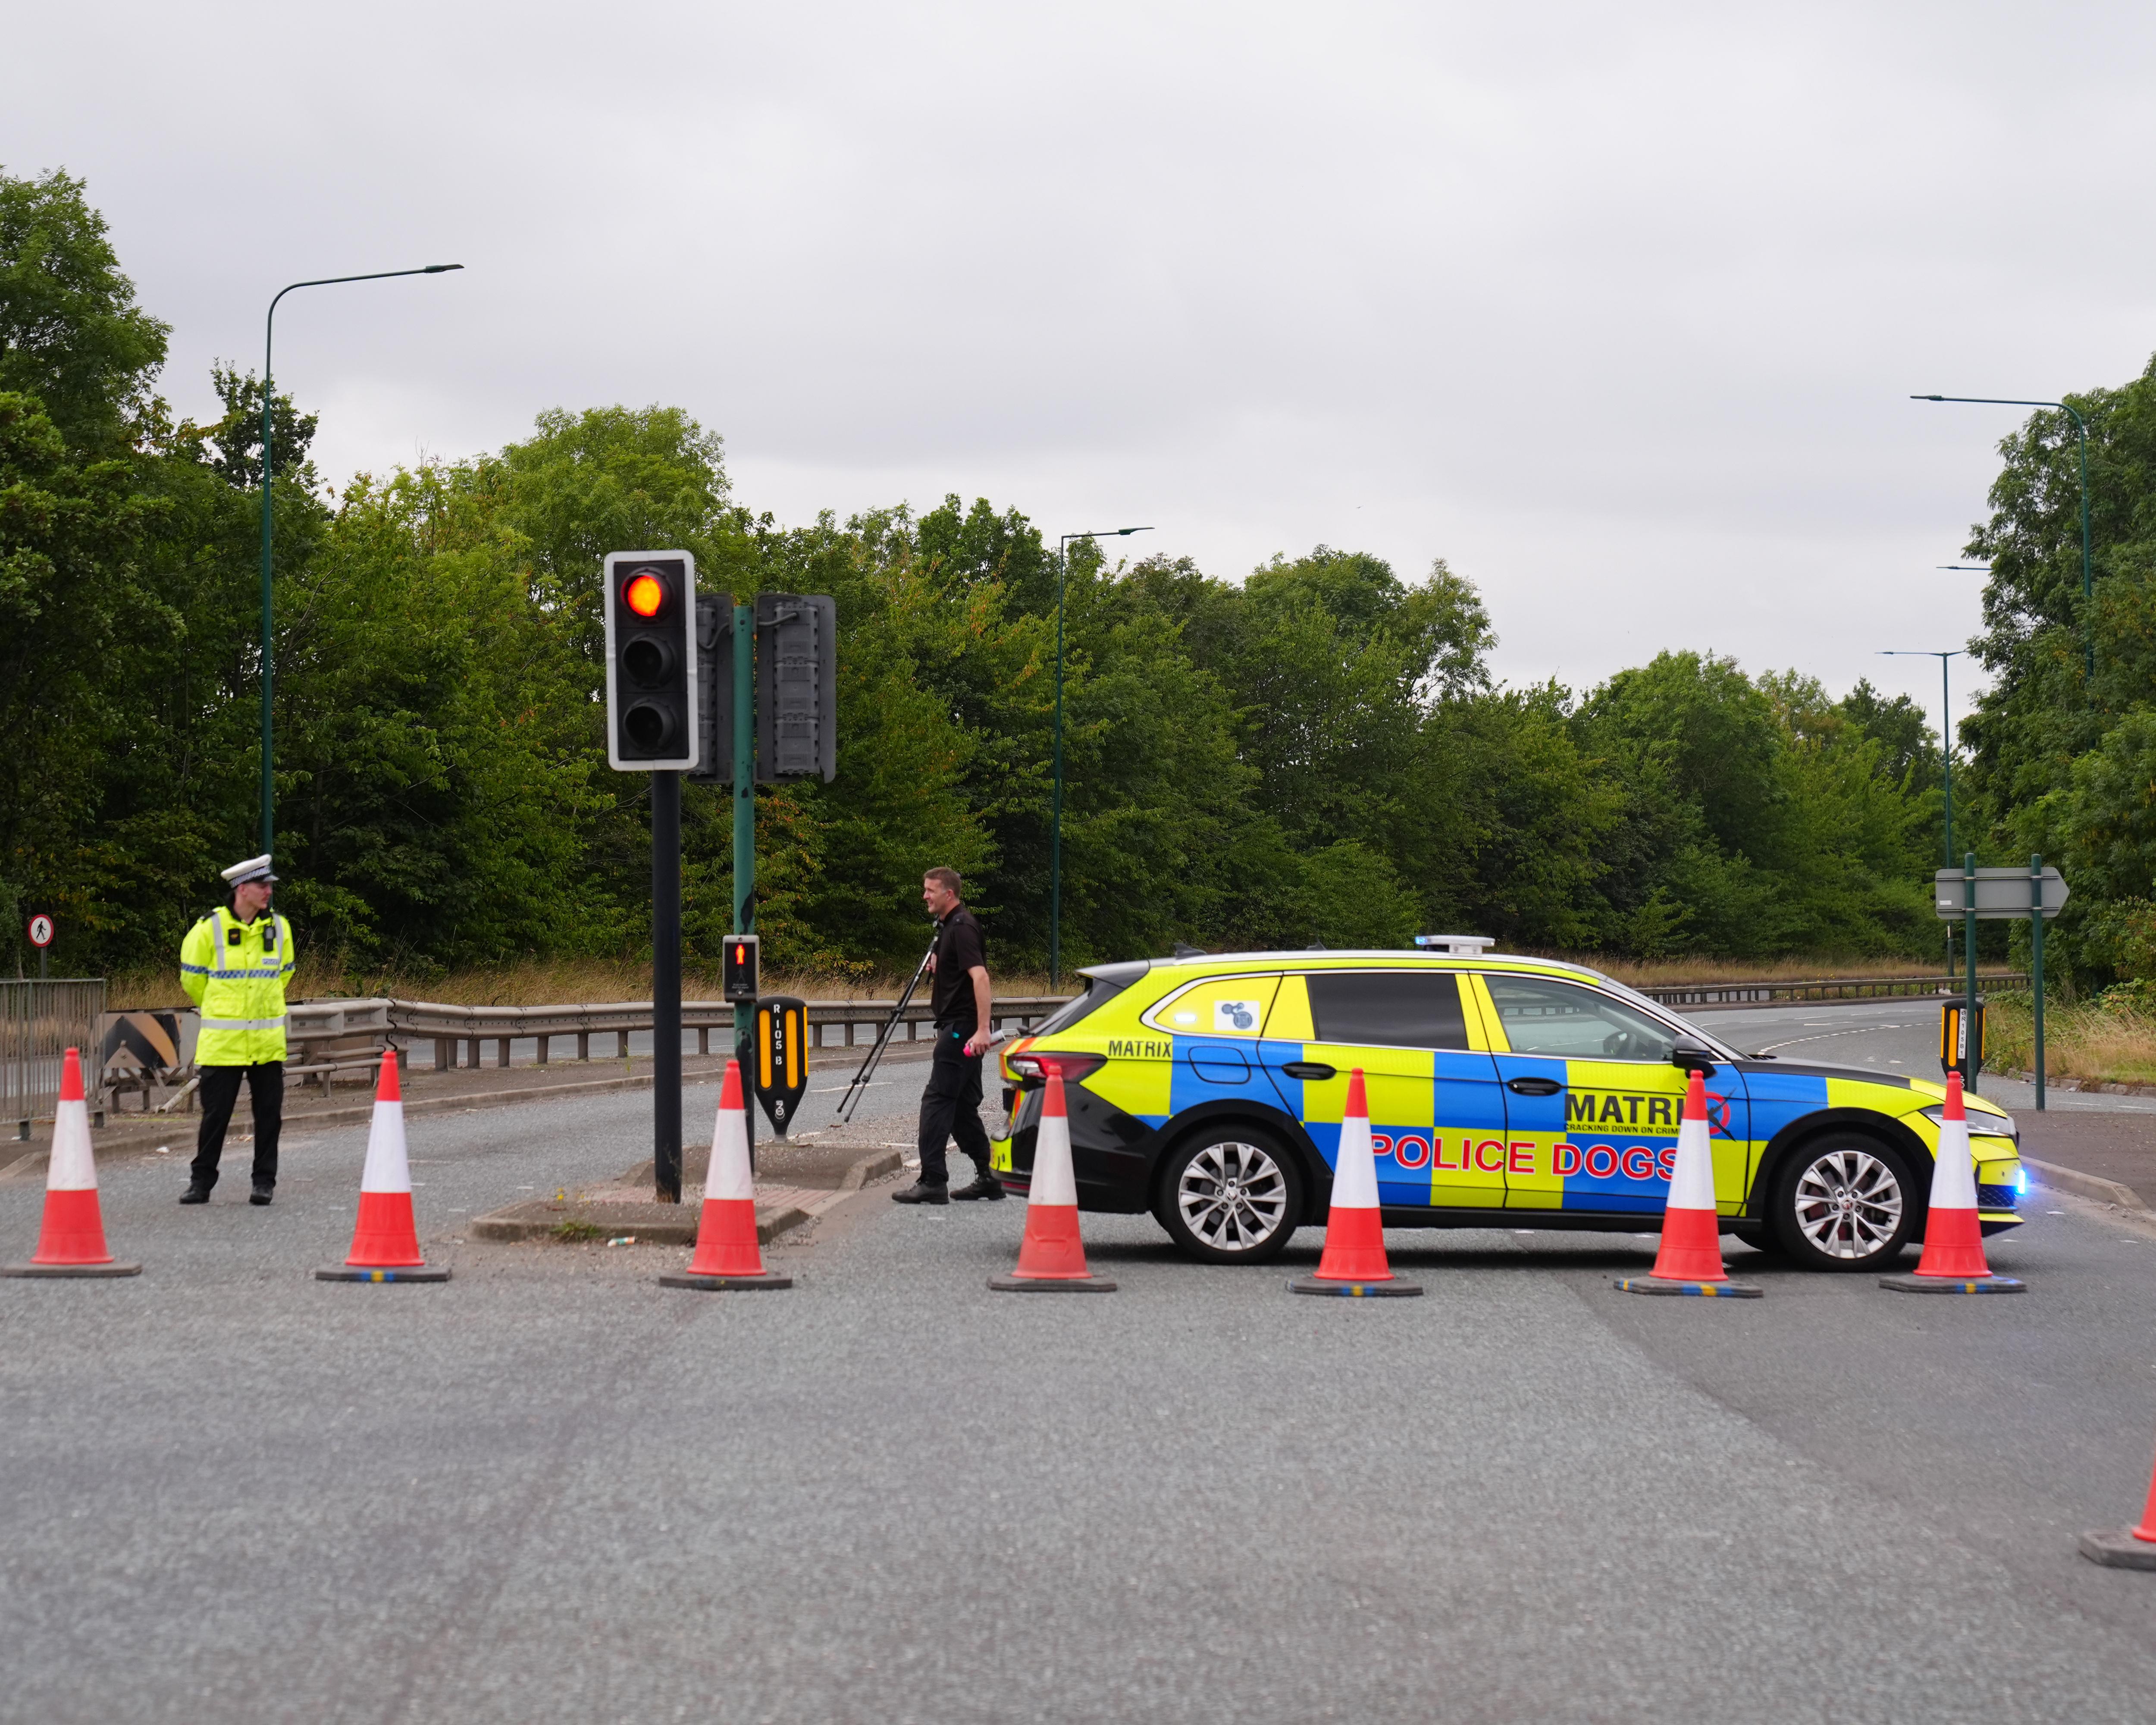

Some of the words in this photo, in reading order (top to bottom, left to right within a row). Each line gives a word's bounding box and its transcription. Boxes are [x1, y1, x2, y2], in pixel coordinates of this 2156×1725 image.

[1109, 1040, 1171, 1057] MATRIX
[1564, 1123, 1609, 1132] CRACKING
[1612, 1125, 1638, 1133] DOWN
[1656, 1127, 1681, 1135] CRIM
[1371, 1133, 1536, 1175] POLICE
